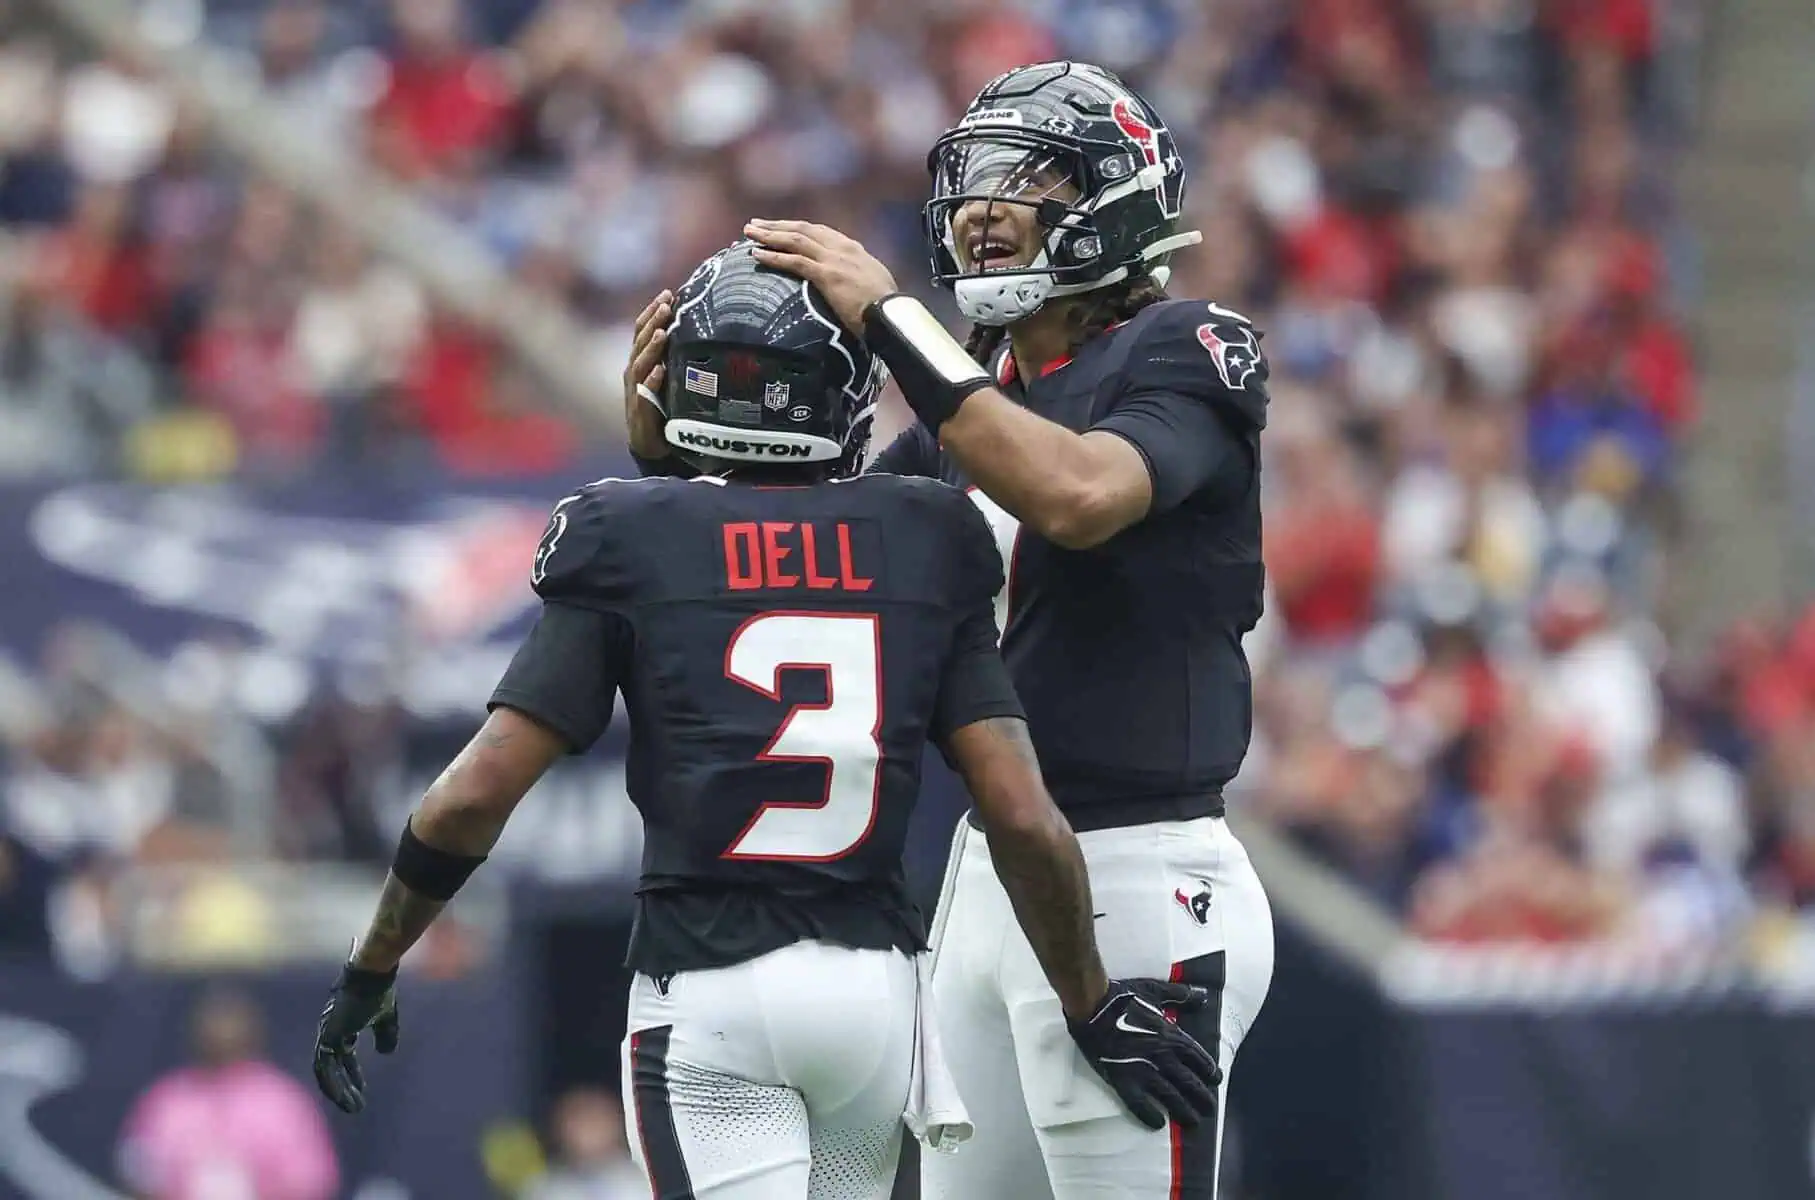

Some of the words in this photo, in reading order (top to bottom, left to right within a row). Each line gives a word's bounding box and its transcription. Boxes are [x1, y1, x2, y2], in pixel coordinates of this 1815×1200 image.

[678, 431, 812, 457] HOUSTON
[723, 521, 874, 590] DELL
[719, 610, 884, 863] 3
